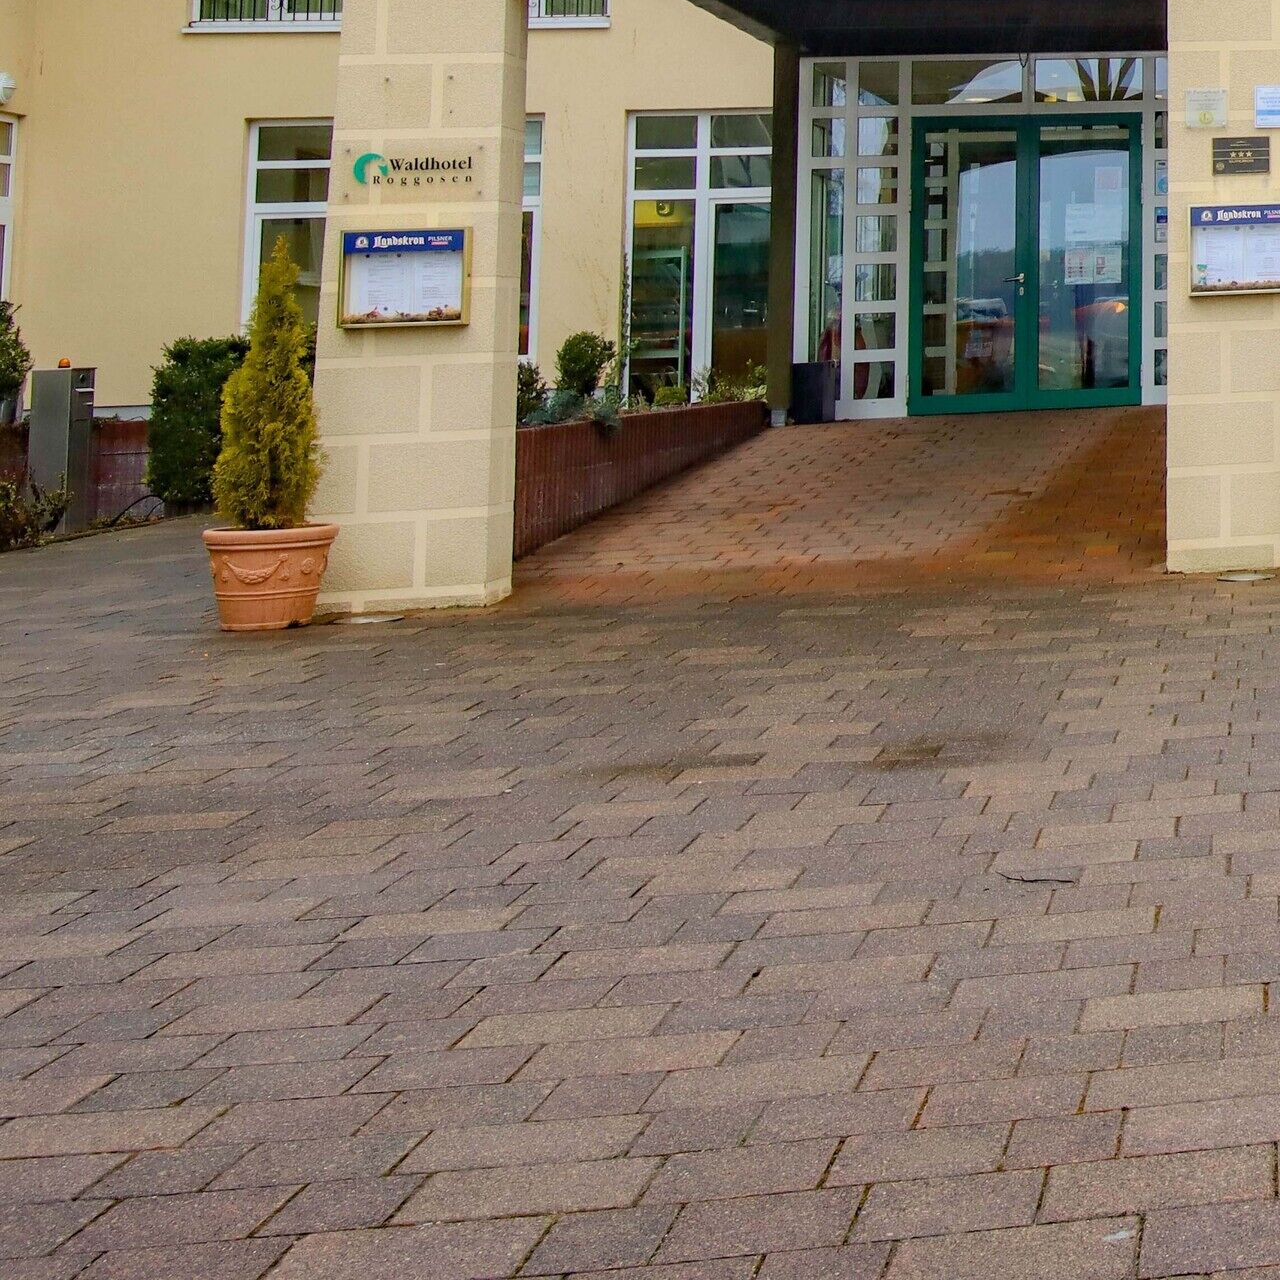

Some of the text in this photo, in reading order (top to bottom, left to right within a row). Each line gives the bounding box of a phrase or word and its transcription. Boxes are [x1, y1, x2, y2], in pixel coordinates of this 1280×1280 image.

[389, 156, 473, 172] Waldhotel
[372, 175, 472, 186] Roggosen
[1216, 209, 1262, 221] Landskron
[373, 235, 425, 248] Landskron
